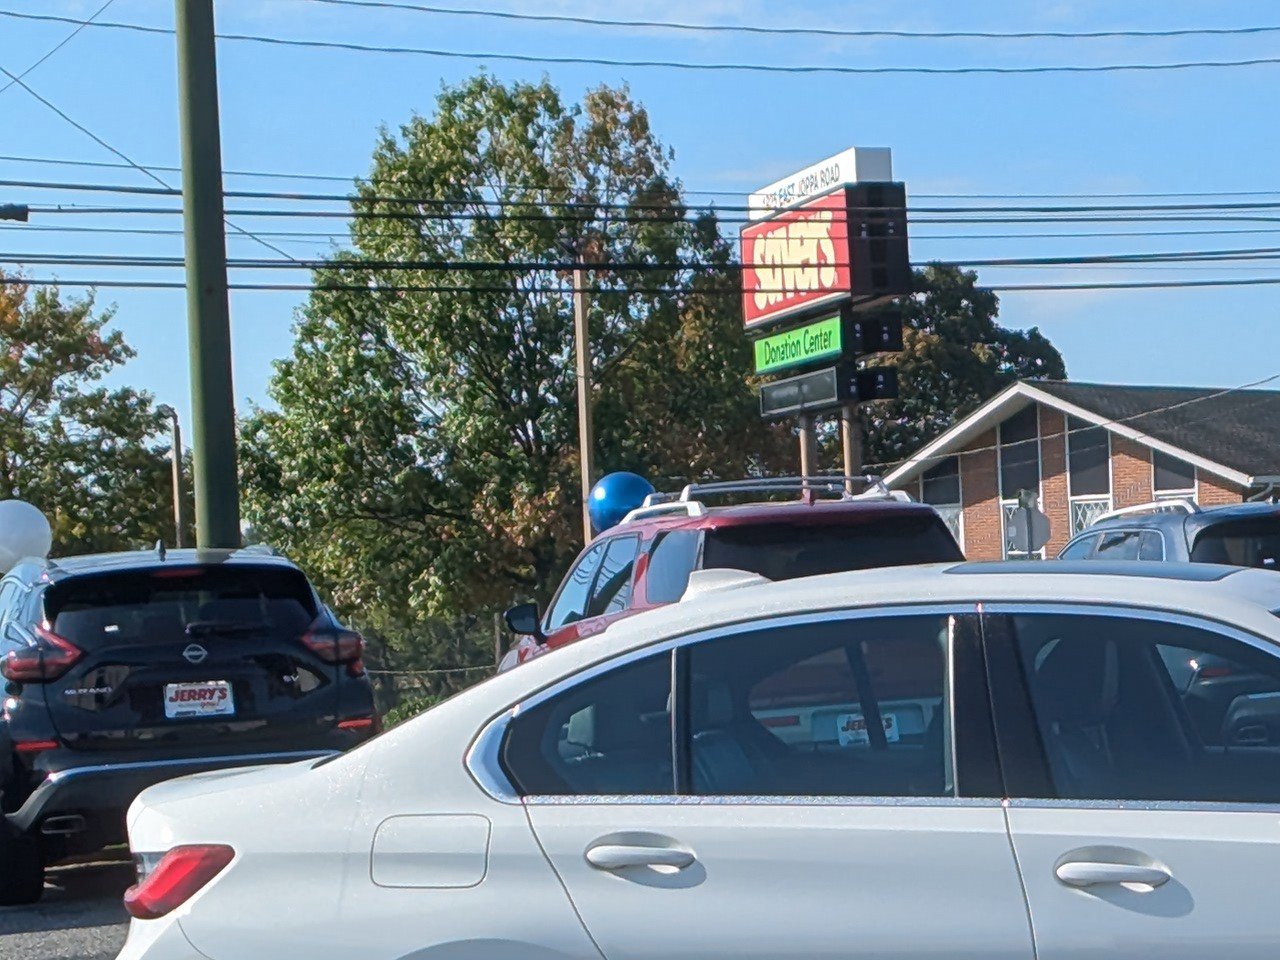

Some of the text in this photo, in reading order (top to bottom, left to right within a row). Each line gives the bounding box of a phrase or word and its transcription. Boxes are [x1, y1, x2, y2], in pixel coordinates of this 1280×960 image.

[797, 171, 820, 198] JOPPA
[820, 162, 840, 188] ROAD
[764, 328, 833, 365] Donation Center
[168, 687, 228, 703] JERRY'S
